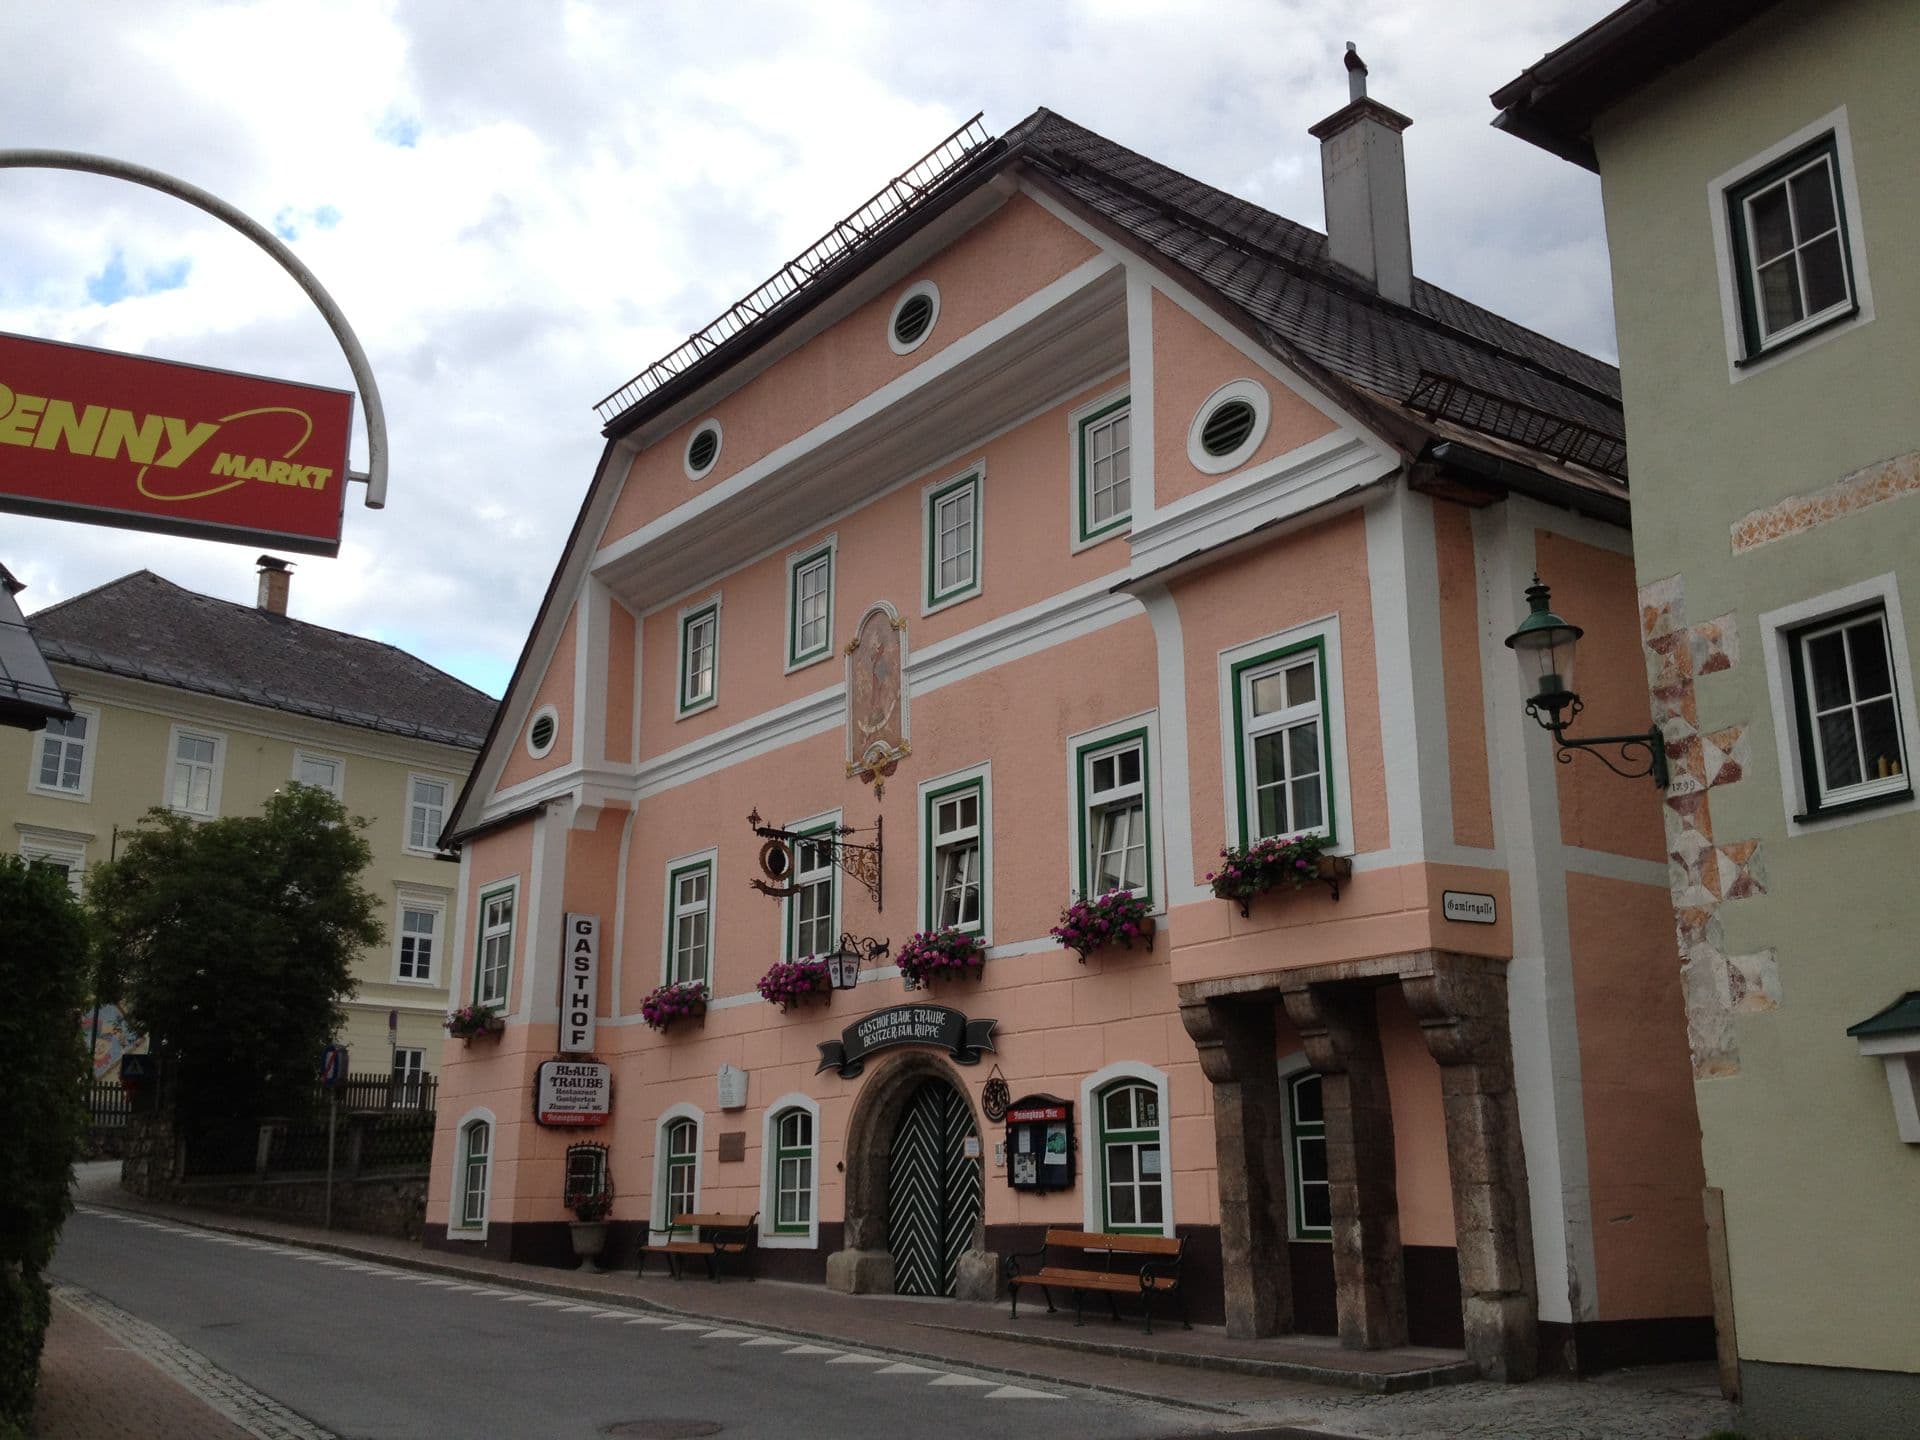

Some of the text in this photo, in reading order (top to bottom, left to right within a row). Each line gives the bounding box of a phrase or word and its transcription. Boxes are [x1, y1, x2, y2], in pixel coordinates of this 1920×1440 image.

[210, 452, 333, 490] MARKT
[571, 920, 593, 1045] GASTHOF
[858, 1009, 947, 1037] GASTHOF BLAUE TRAUBE
[550, 1076, 604, 1089] TRAUBE
[556, 1065, 599, 1077] BLAUE
